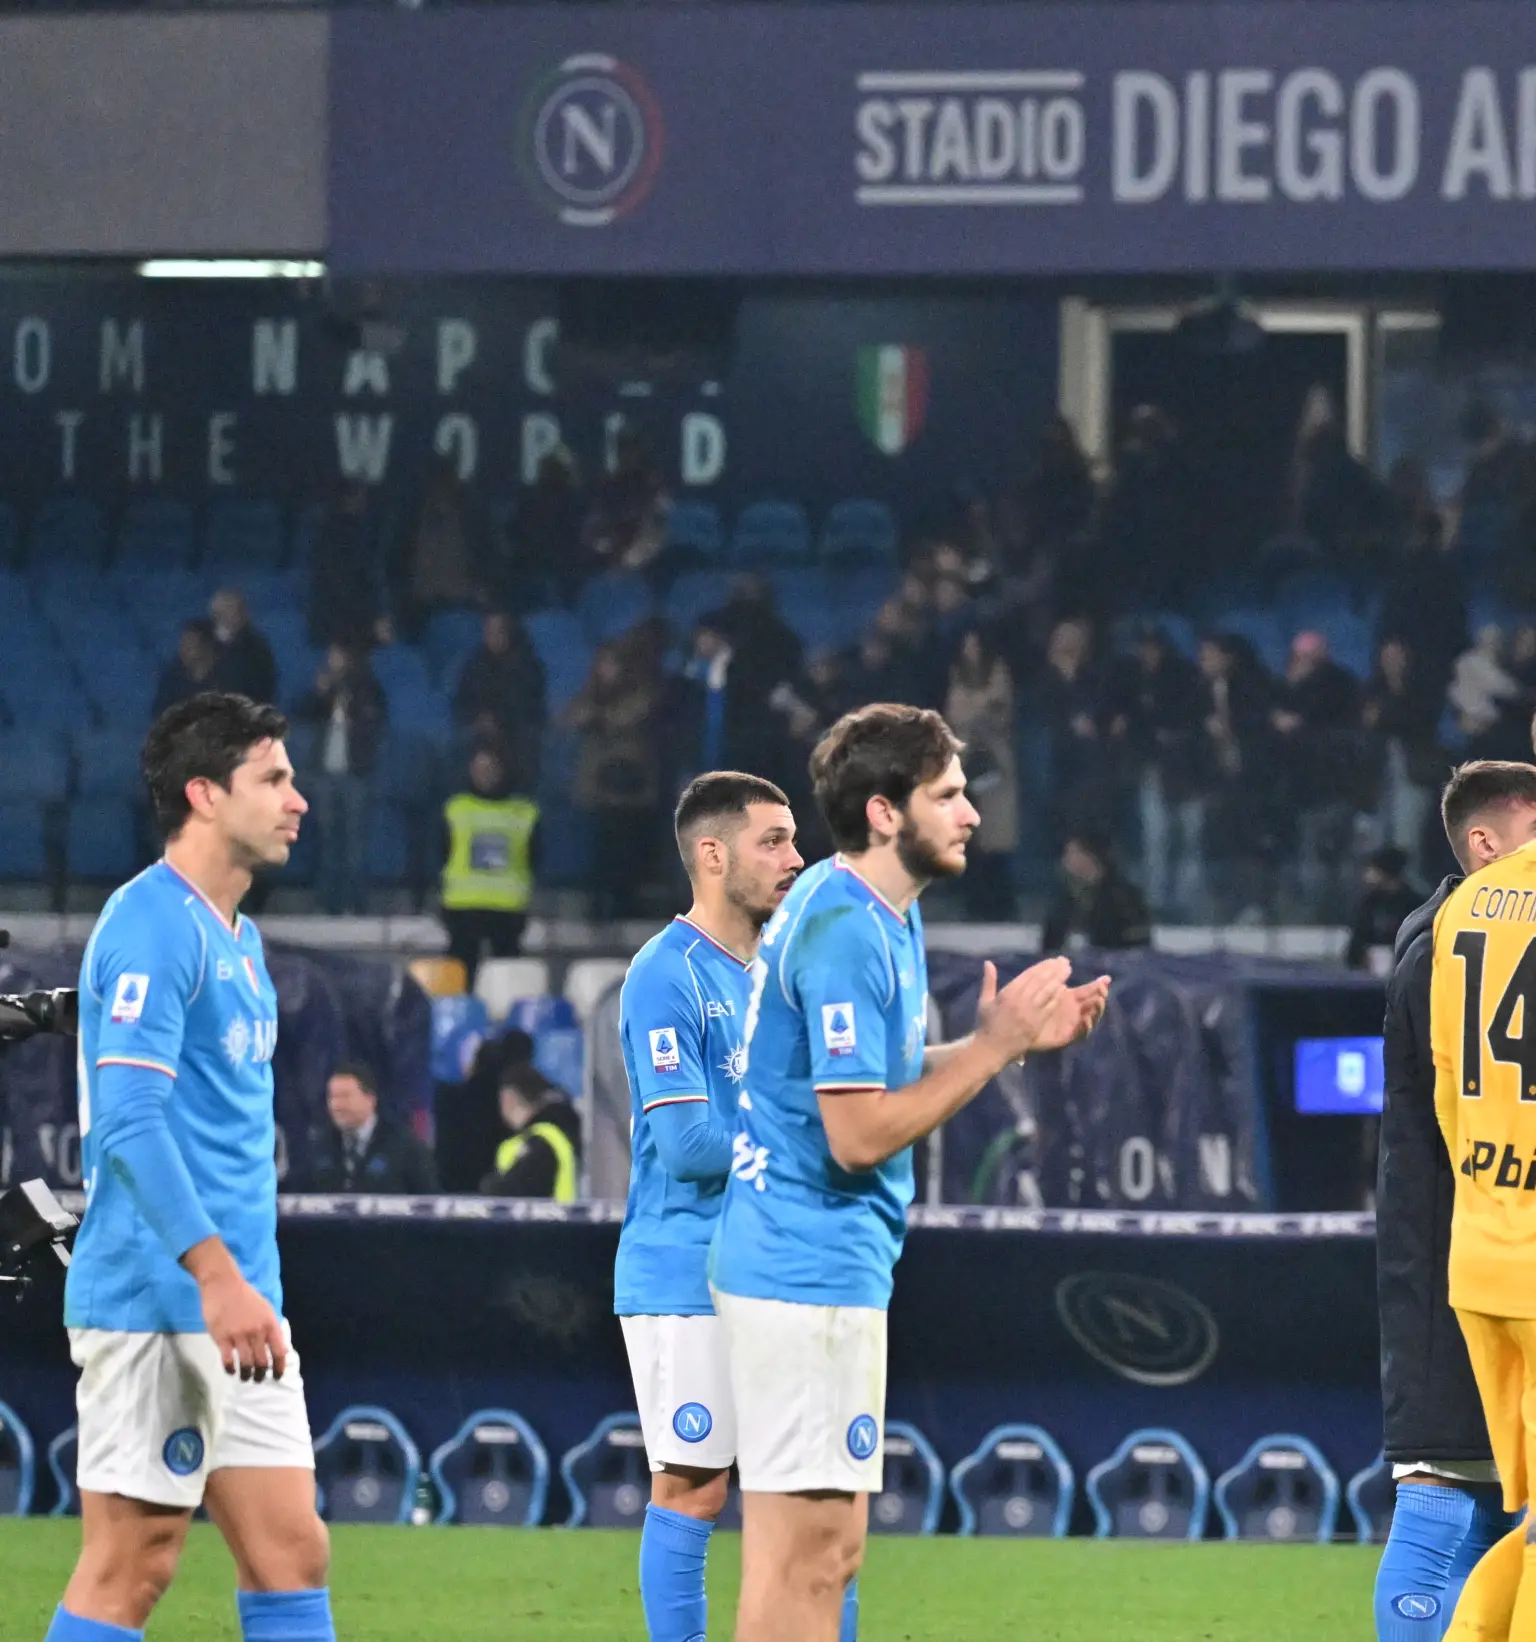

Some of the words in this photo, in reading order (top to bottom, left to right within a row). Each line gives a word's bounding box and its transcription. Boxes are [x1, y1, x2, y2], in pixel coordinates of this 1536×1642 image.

[856, 98, 1084, 181] STADIO
[1112, 67, 1420, 202] DIEGO
[55, 409, 238, 484] THE
[707, 1000, 736, 1018] EA7
[664, 1064, 678, 1072] TIM
